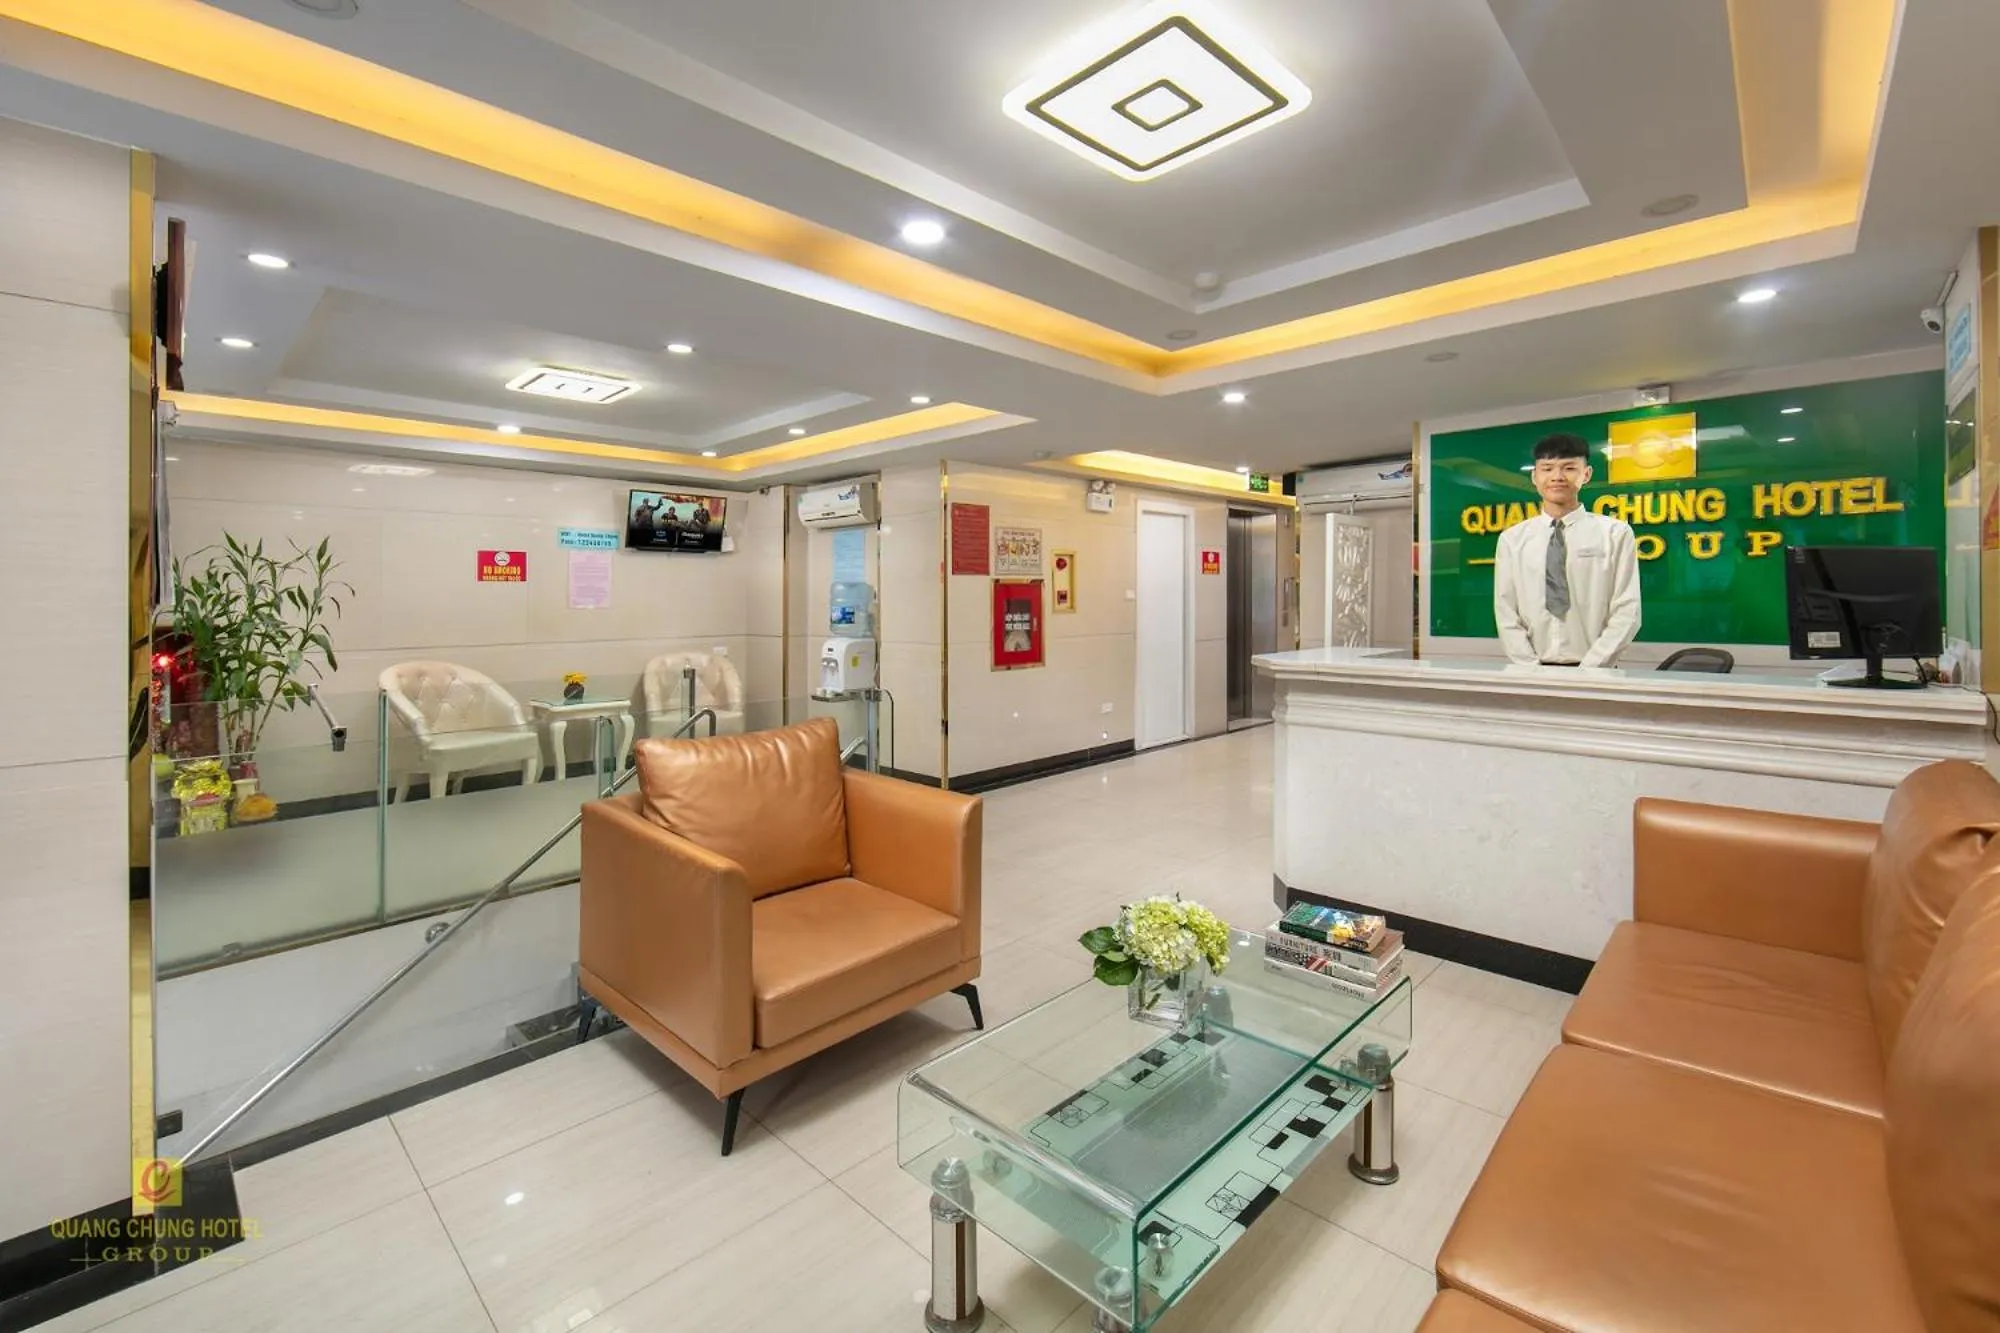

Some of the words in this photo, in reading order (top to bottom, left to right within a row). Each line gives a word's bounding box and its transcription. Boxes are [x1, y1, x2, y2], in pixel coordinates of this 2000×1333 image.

[1461, 501, 1543, 535] QUAN
[1592, 487, 1726, 525] CHUNG
[1753, 476, 1904, 519] HOTEL
[1636, 531, 1784, 561] OUP
